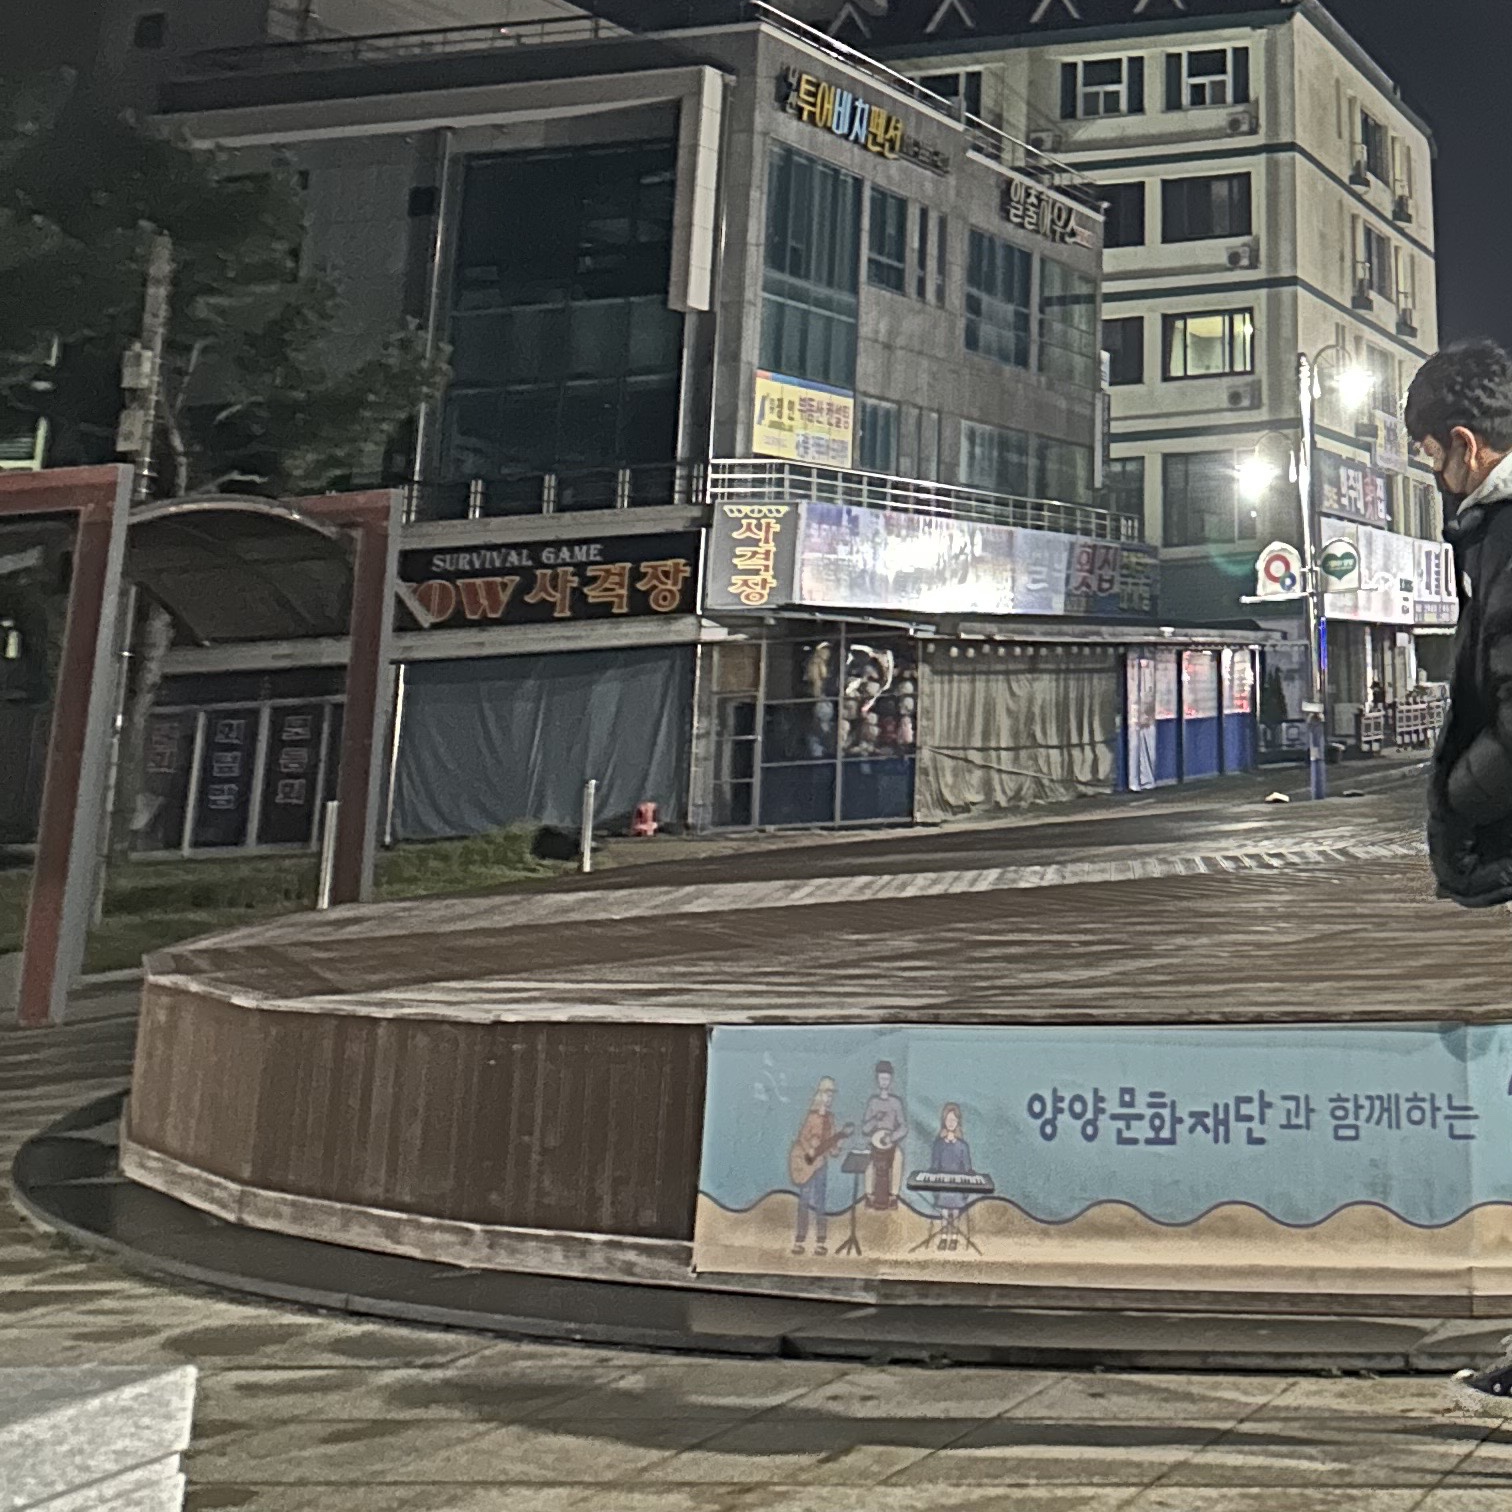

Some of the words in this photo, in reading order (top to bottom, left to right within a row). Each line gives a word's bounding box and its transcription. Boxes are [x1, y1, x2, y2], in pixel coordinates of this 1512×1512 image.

[723, 504, 790, 518] WOW
[431, 548, 534, 573] SURVIVAL
[541, 544, 604, 565] GAME
[727, 518, 781, 606] 사격장
[397, 576, 520, 624] OW
[524, 558, 692, 618] 사격장
[1026, 1087, 1316, 1147] 양양문화재단과
[1328, 1092, 1480, 1142] 함께하는
